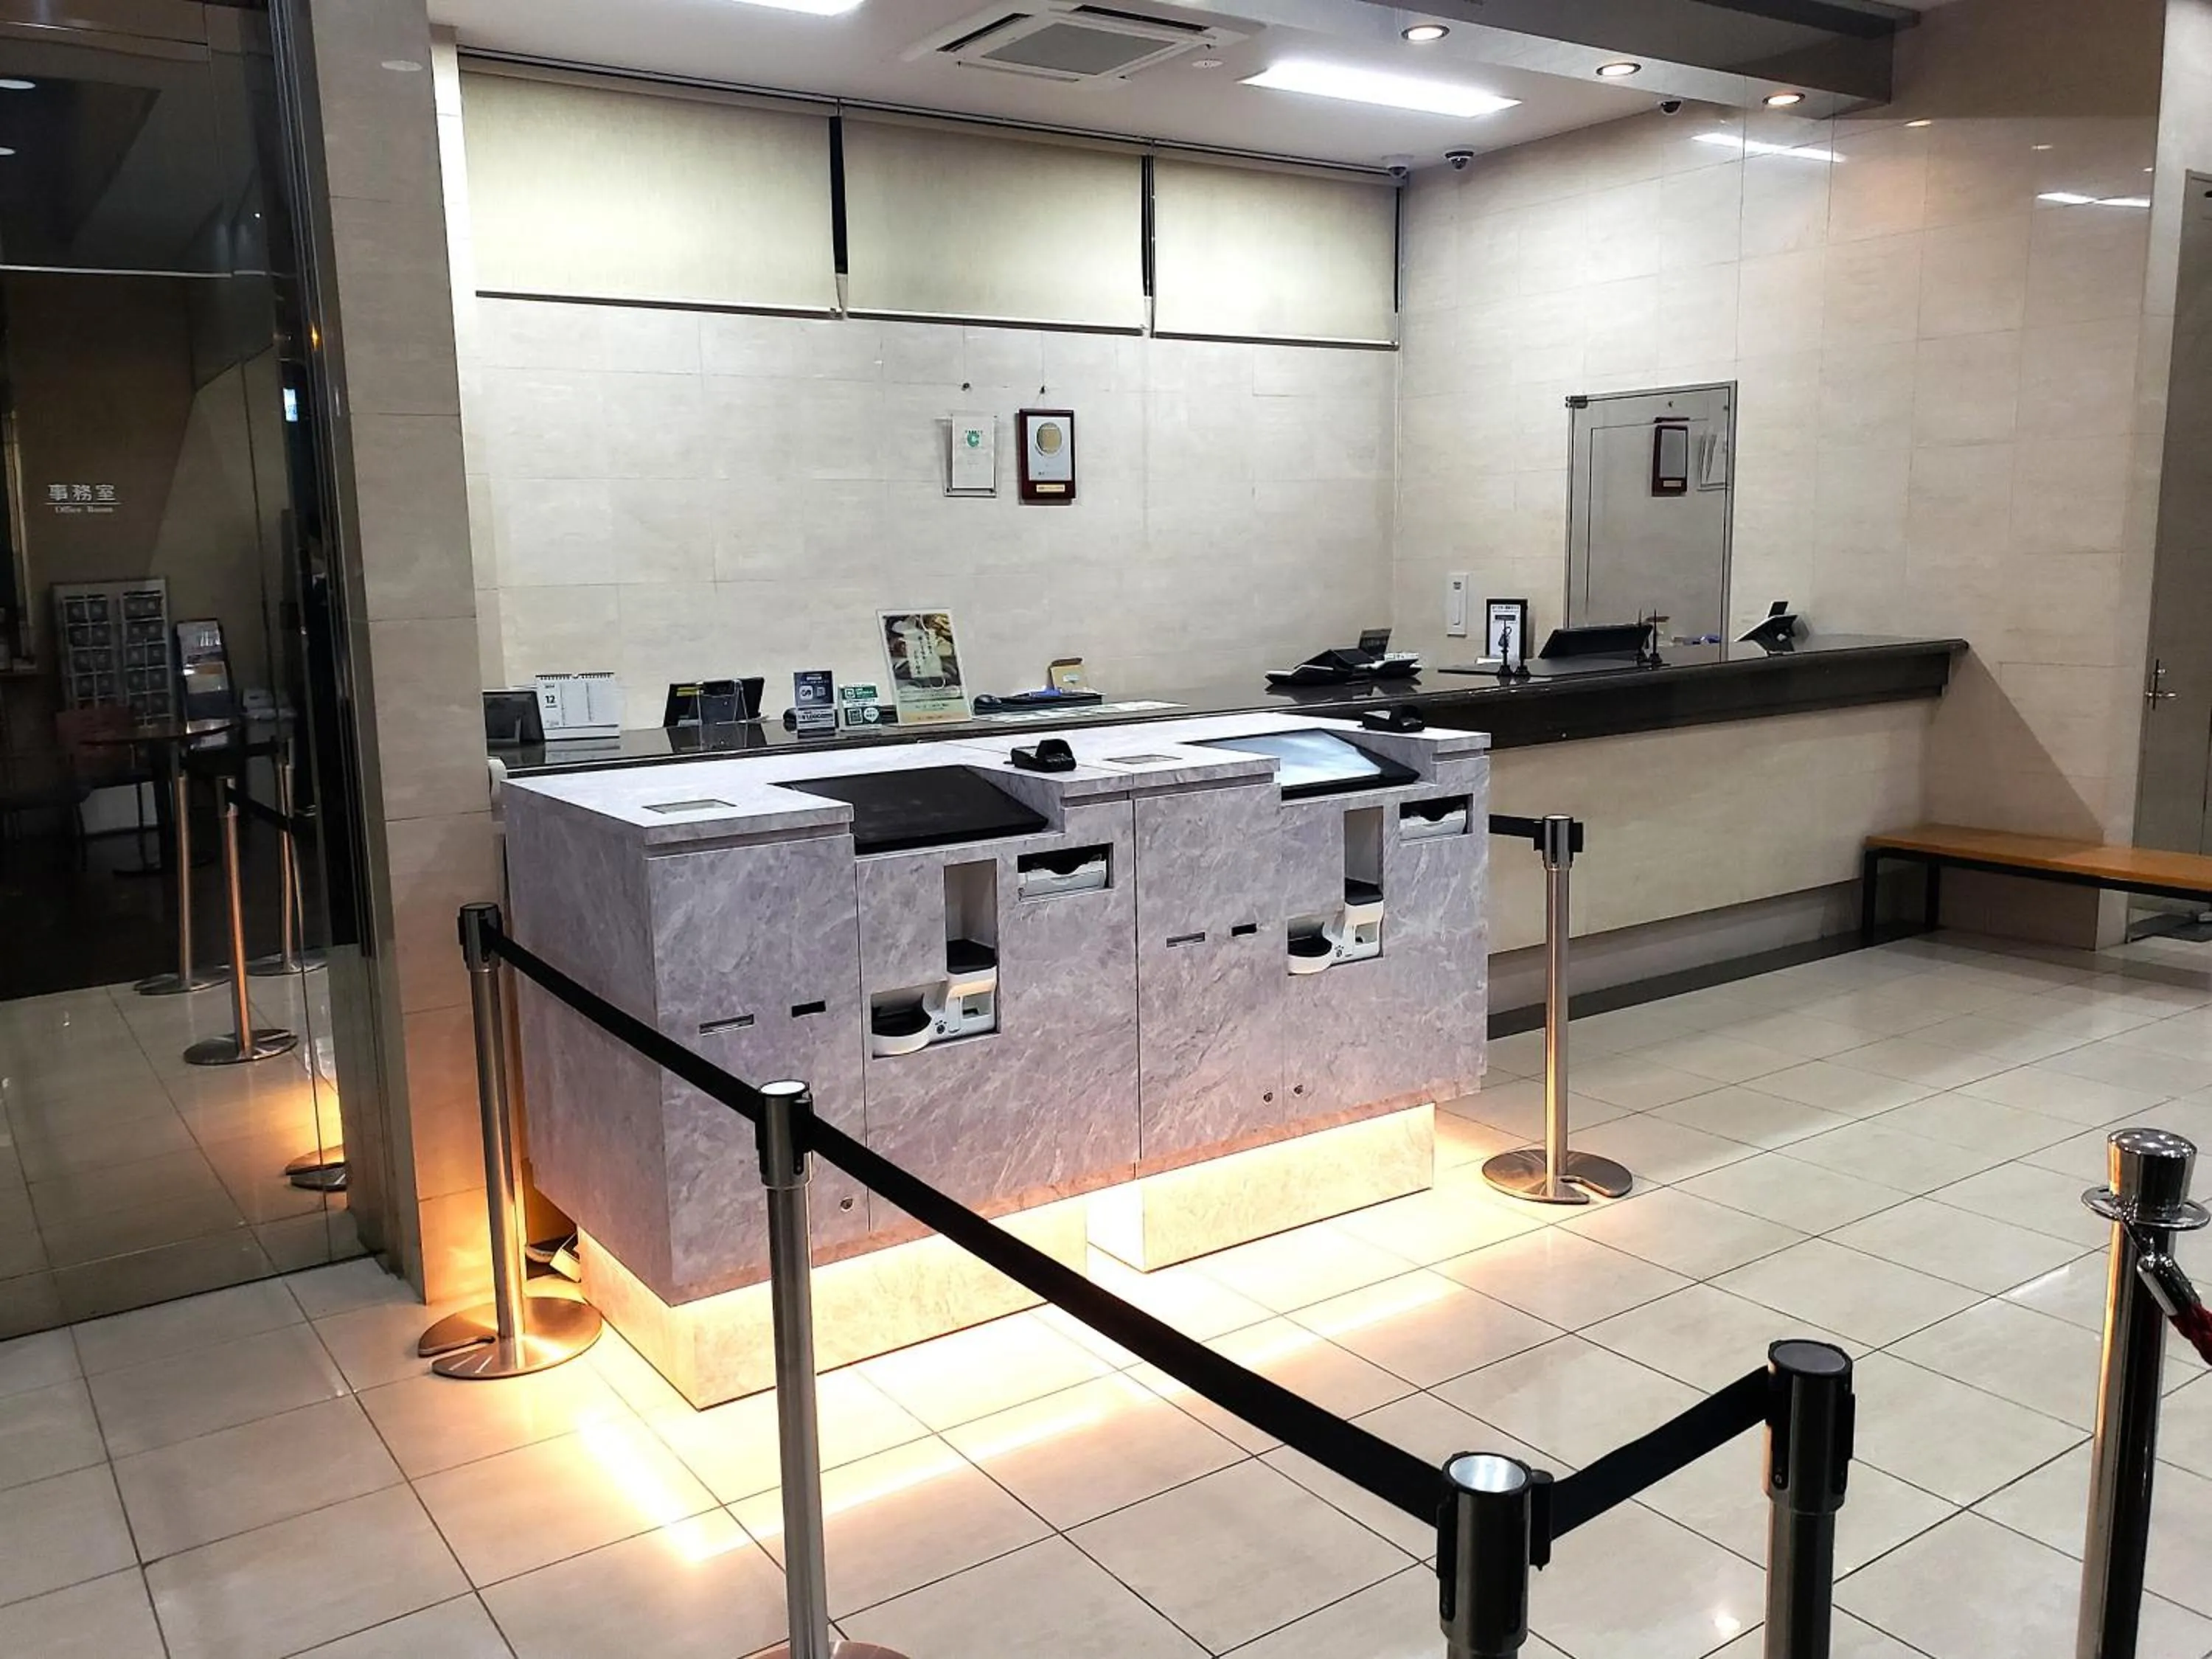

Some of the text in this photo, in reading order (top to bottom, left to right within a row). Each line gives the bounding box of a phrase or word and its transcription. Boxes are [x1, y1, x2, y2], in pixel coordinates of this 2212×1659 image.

[48, 484, 116, 501] 事務室
[545, 695, 555, 703] 12
